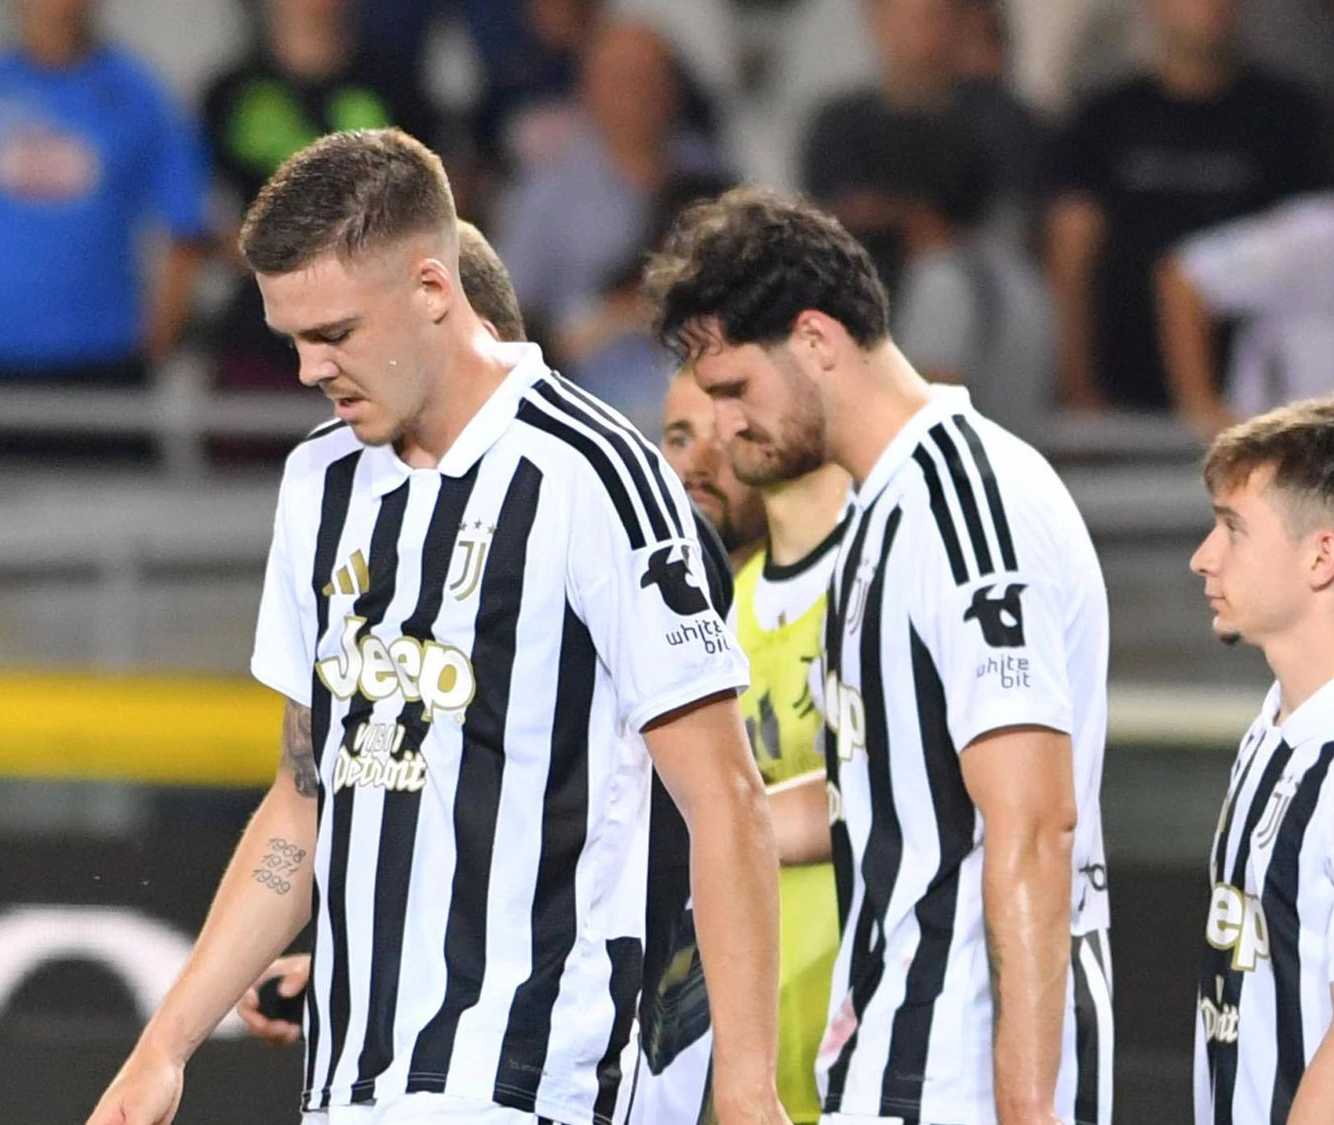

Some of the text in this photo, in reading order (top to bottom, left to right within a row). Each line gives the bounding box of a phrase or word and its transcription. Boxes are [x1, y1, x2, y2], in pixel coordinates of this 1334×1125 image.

[665, 619, 723, 646] white
[315, 615, 476, 723] Jeep
[1000, 671, 1031, 689] bit
[333, 745, 429, 794] Detroit
[268, 838, 306, 864] 1968
[251, 868, 291, 895] 1999
[1206, 881, 1270, 972] ep
